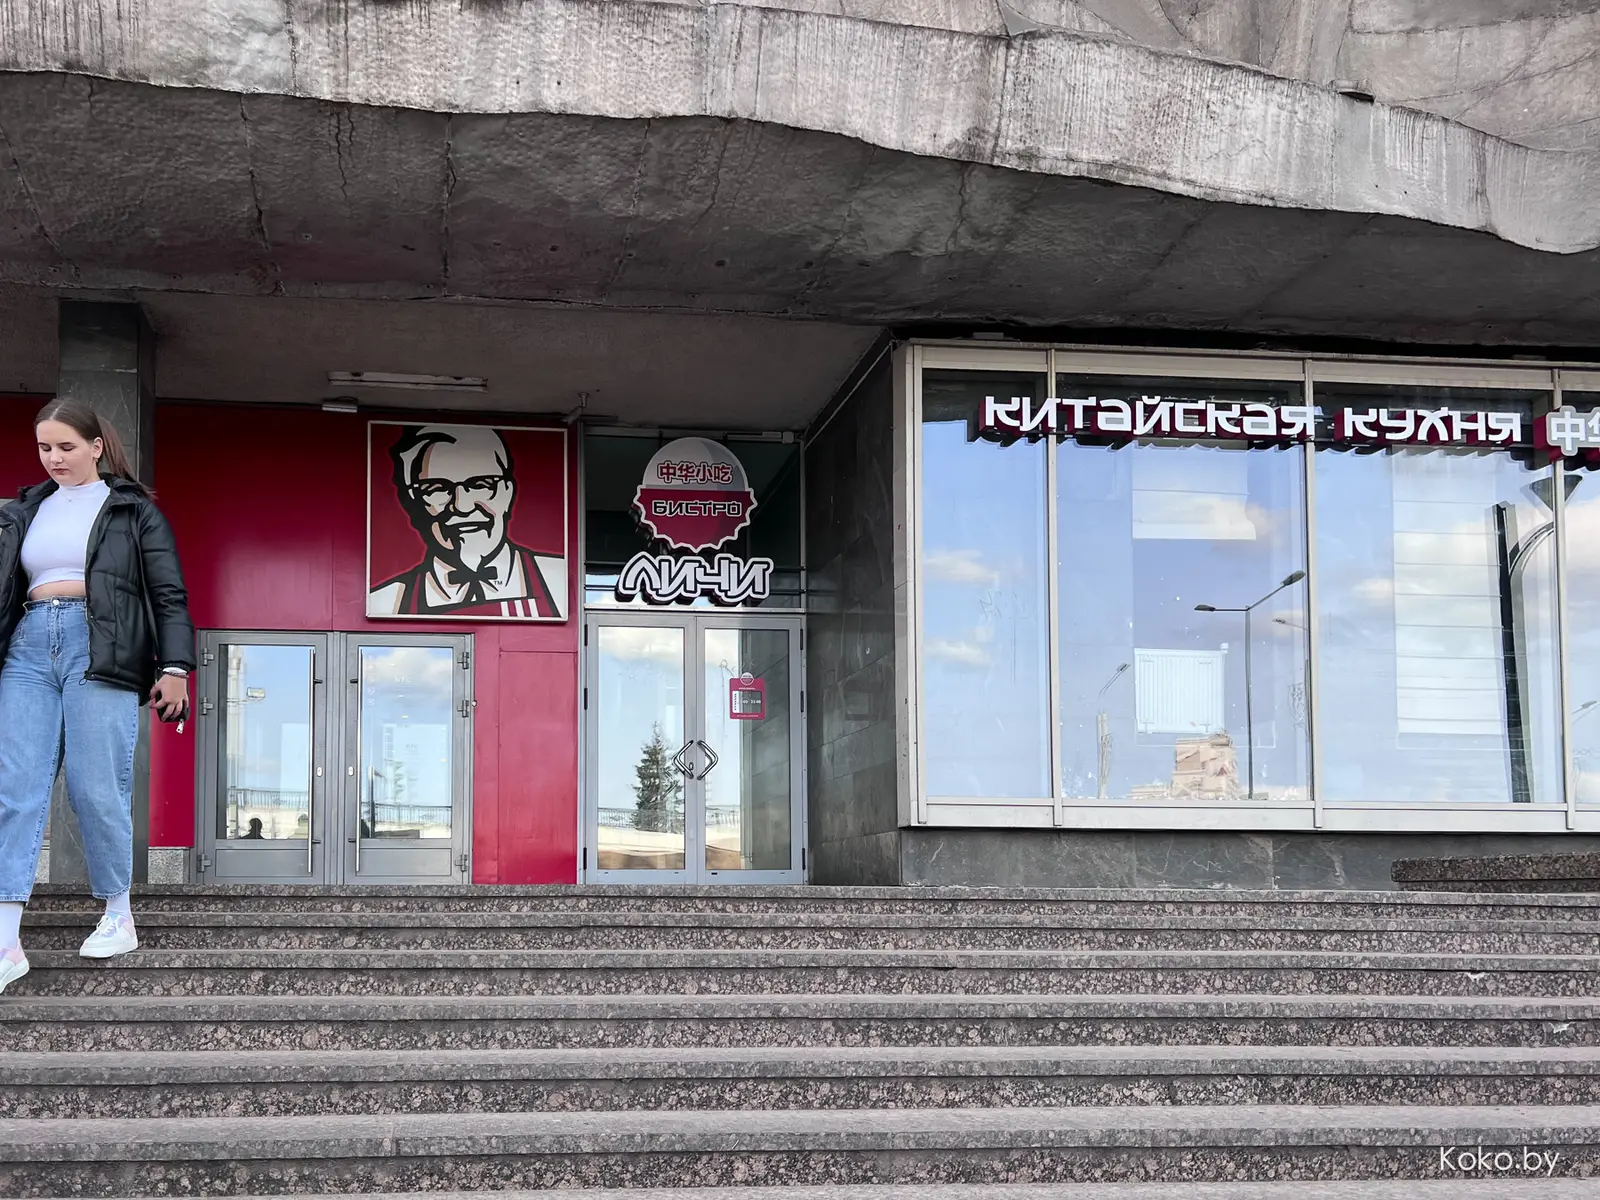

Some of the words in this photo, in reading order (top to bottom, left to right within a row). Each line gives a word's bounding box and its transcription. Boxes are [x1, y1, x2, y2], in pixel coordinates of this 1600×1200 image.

[658, 461, 732, 484] 中华小吃
[653, 501, 742, 516] БИСТРО
[620, 552, 773, 602] ЛИЧИ
